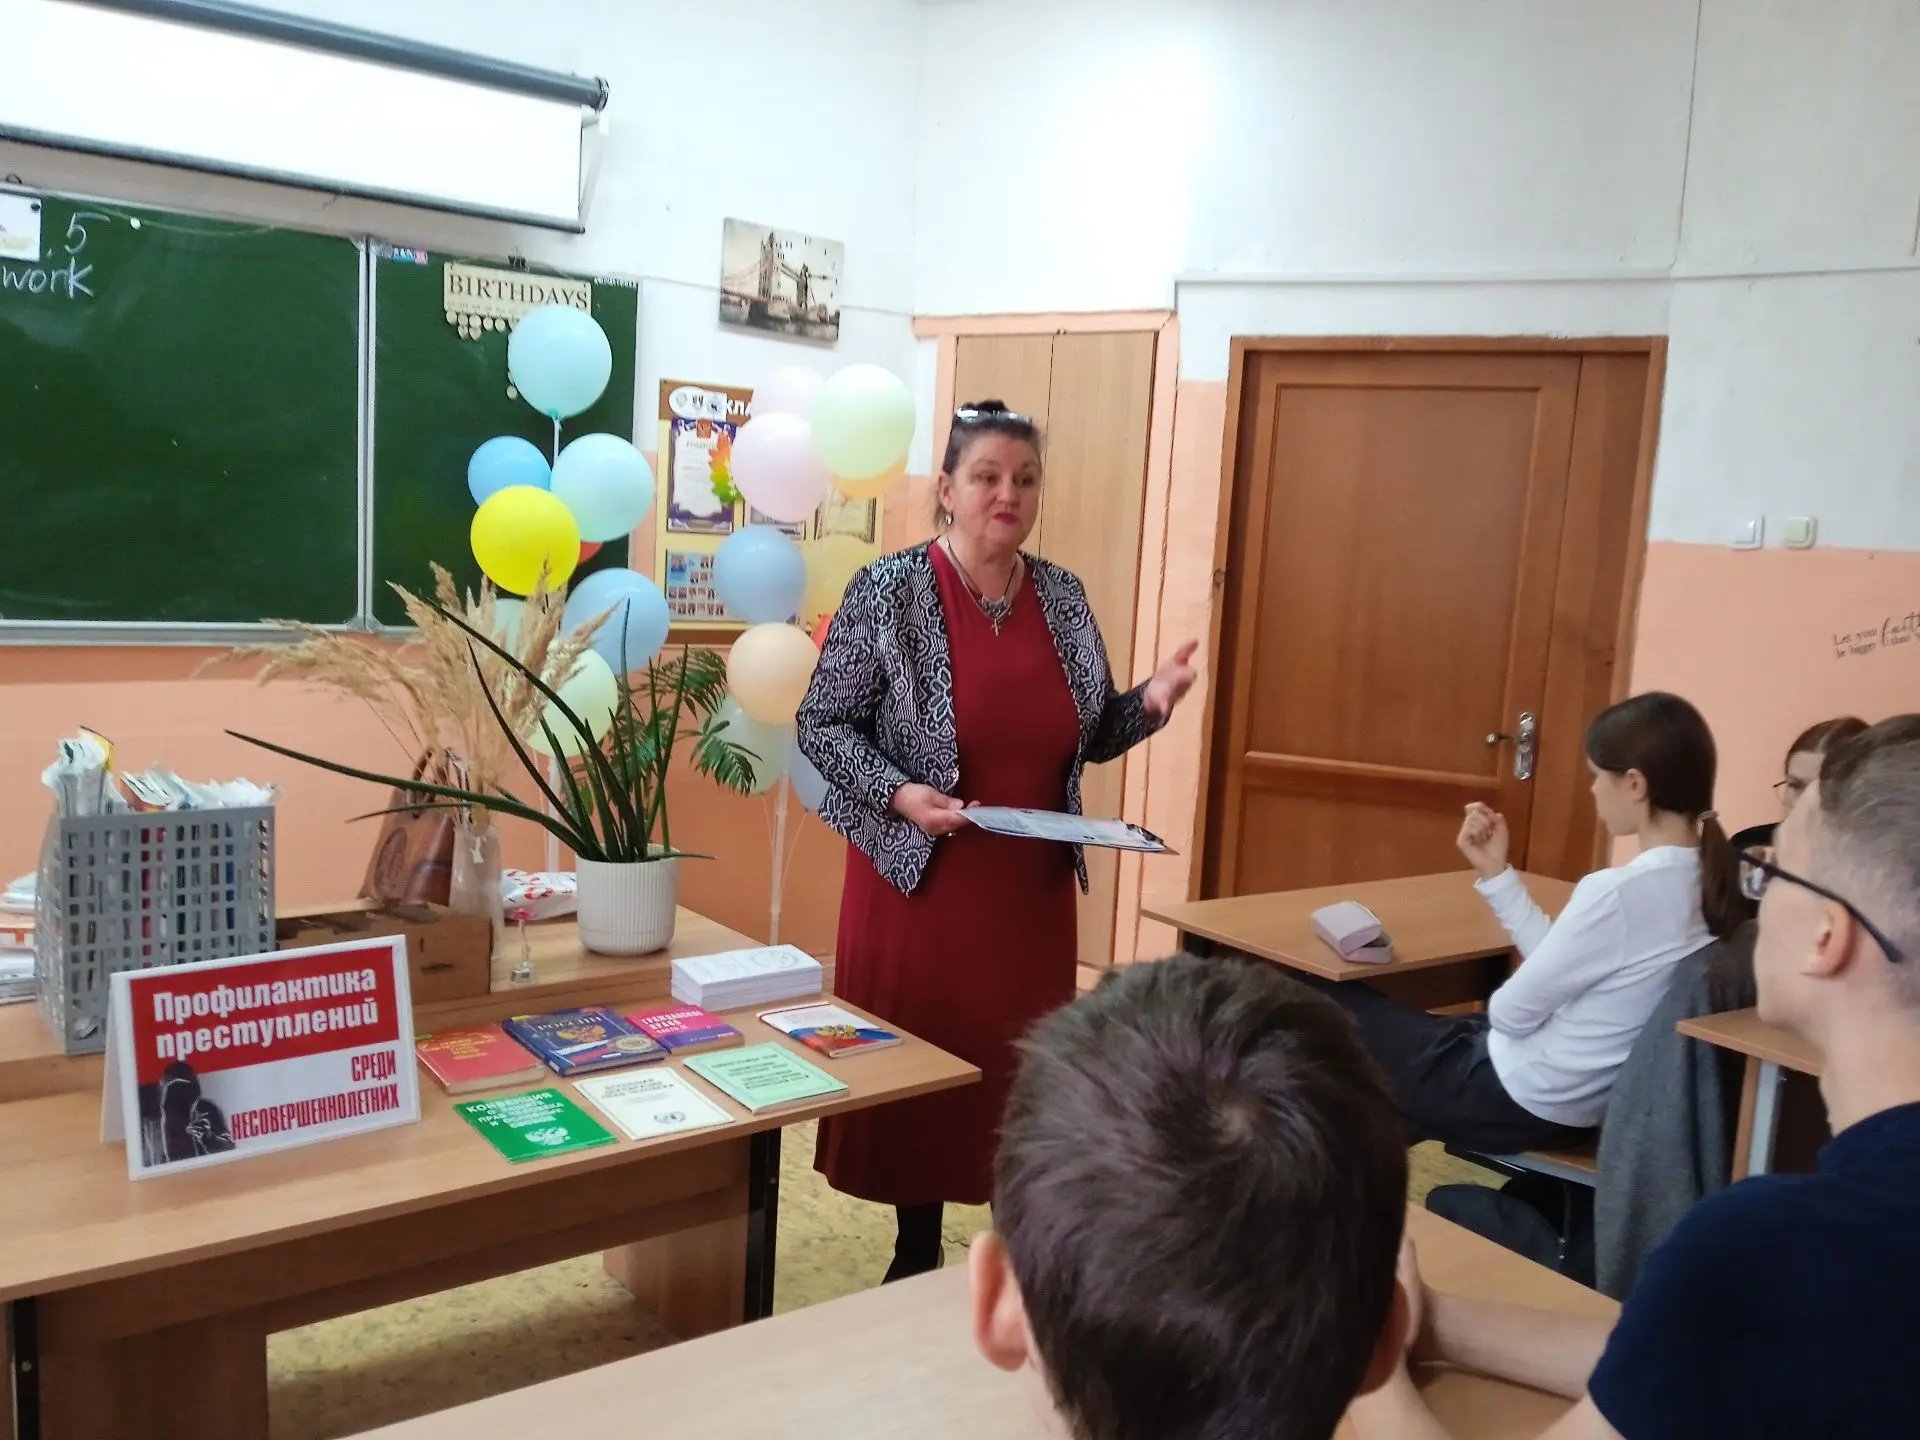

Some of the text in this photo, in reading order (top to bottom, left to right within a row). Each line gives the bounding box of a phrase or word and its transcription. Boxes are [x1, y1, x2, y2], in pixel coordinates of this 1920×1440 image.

[64, 211, 111, 254] 5
[3, 255, 95, 298] work
[449, 273, 588, 310] BIRTHDAYS
[152, 968, 377, 1025] Профилактика
[156, 997, 379, 1061] преступлений
[351, 1049, 397, 1083] СРЕДИ
[230, 1083, 400, 1141] НЕСОВЕРШЕННОЛЕТНИХ
[465, 1092, 553, 1114] КОНВЕНЦИЯ
